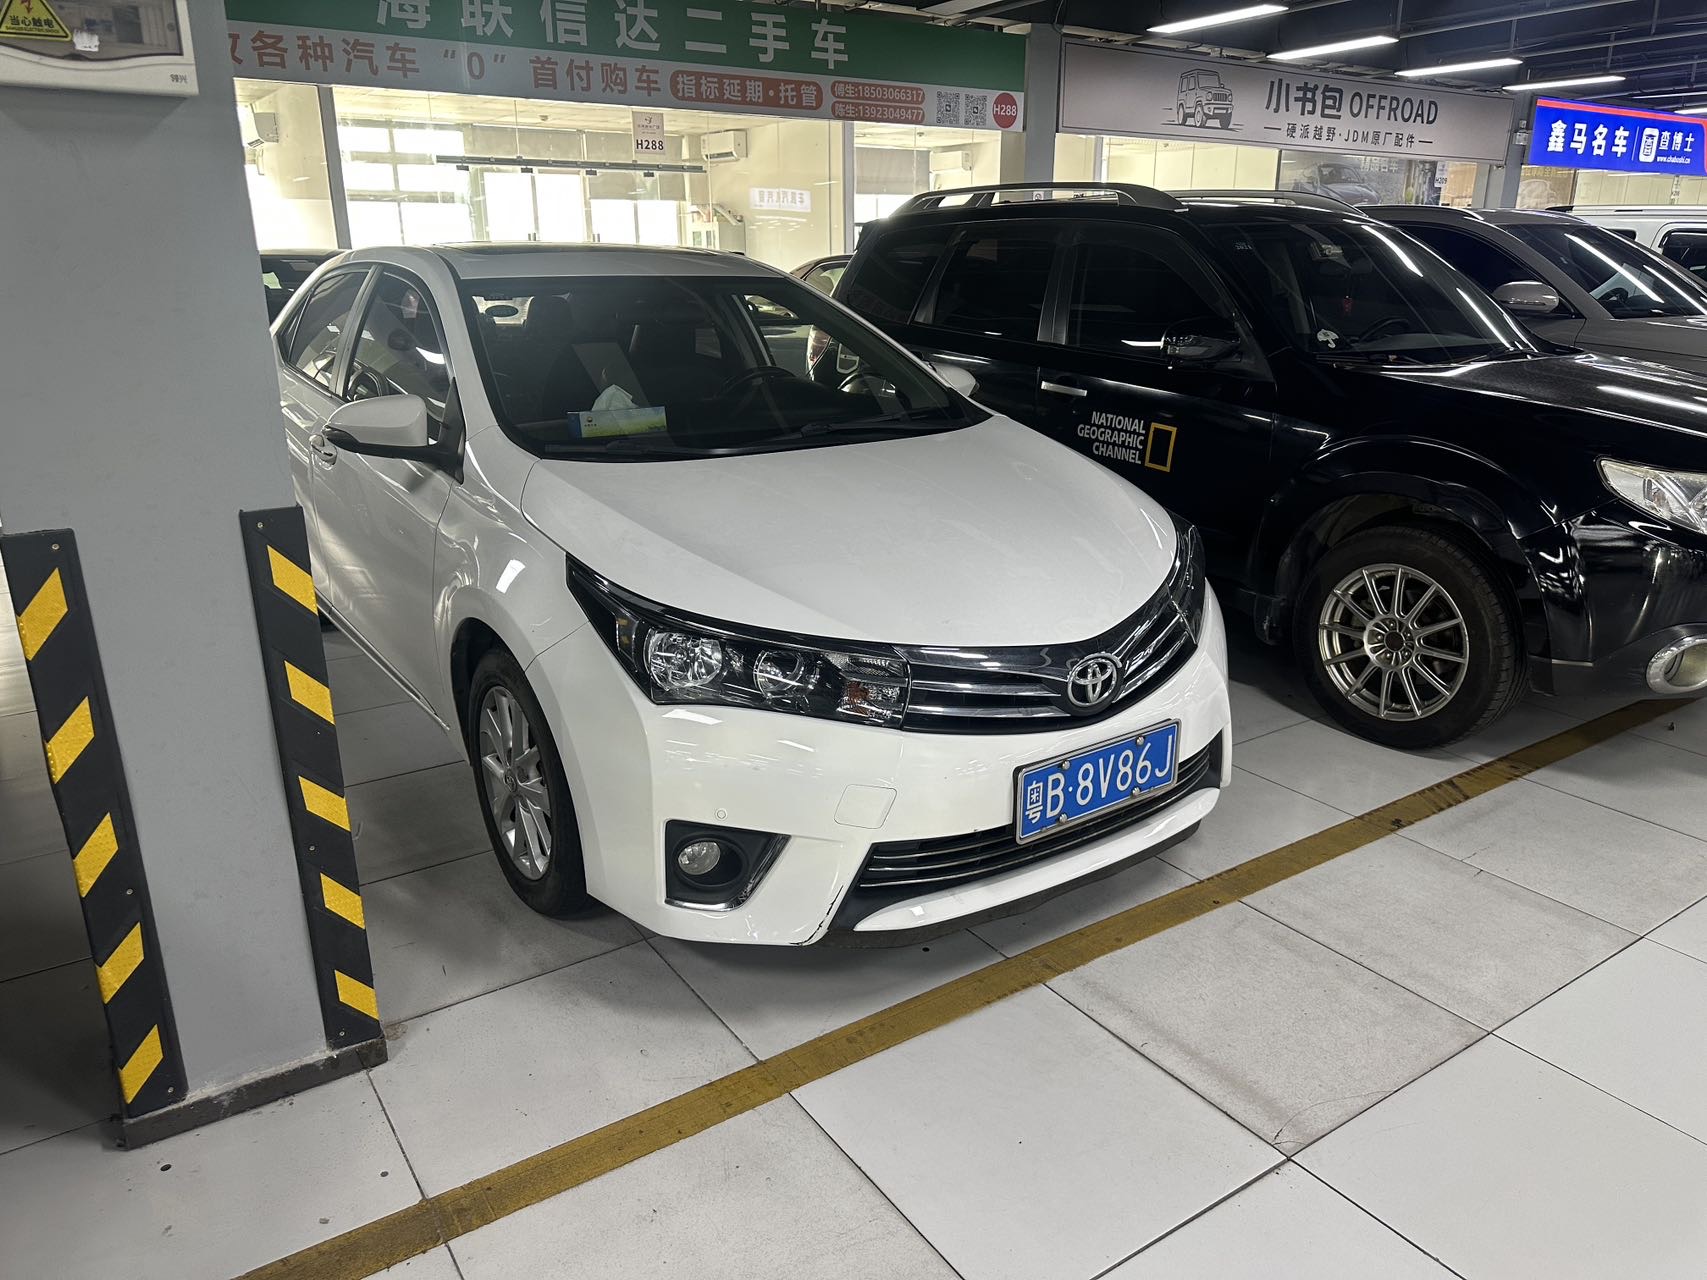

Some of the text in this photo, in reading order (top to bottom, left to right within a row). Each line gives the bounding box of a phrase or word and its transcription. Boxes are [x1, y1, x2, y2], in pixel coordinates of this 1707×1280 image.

[10, 15, 54, 28] 当心触电
[529, 55, 662, 97] 首付购车
[993, 103, 1017, 117] H288
[1265, 78, 1439, 126] 小书包 OFFROAD
[635, 139, 664, 151] H288
[1547, 120, 1630, 158] 鑫马名车
[1658, 131, 1695, 152] 查博士
[1091, 411, 1146, 434] NATIONAL
[1077, 424, 1145, 449] GEOGRAPHIC
[1092, 442, 1142, 464] CHANNEL
